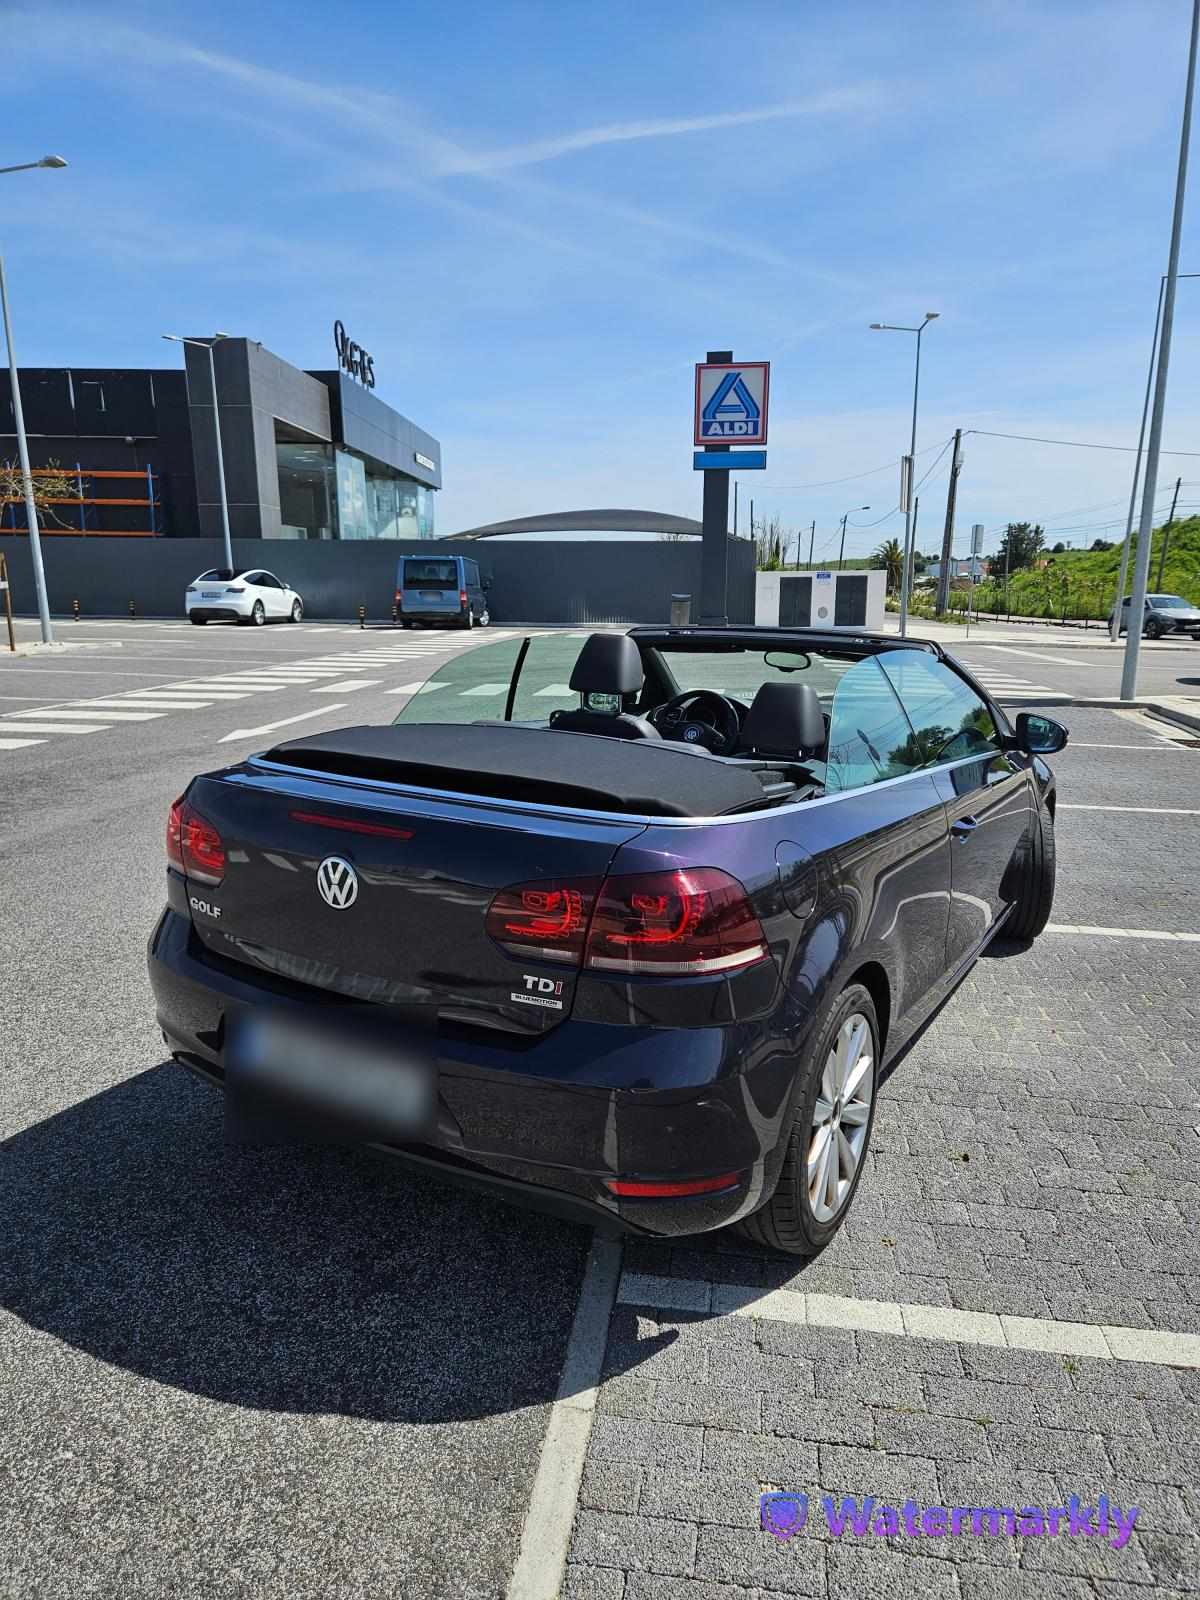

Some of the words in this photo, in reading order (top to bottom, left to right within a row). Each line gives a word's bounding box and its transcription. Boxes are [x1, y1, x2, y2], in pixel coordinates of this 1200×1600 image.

[707, 421, 754, 435] ALDI
[317, 856, 358, 910] VW
[189, 896, 222, 919] GOLF
[523, 974, 564, 995] TDI
